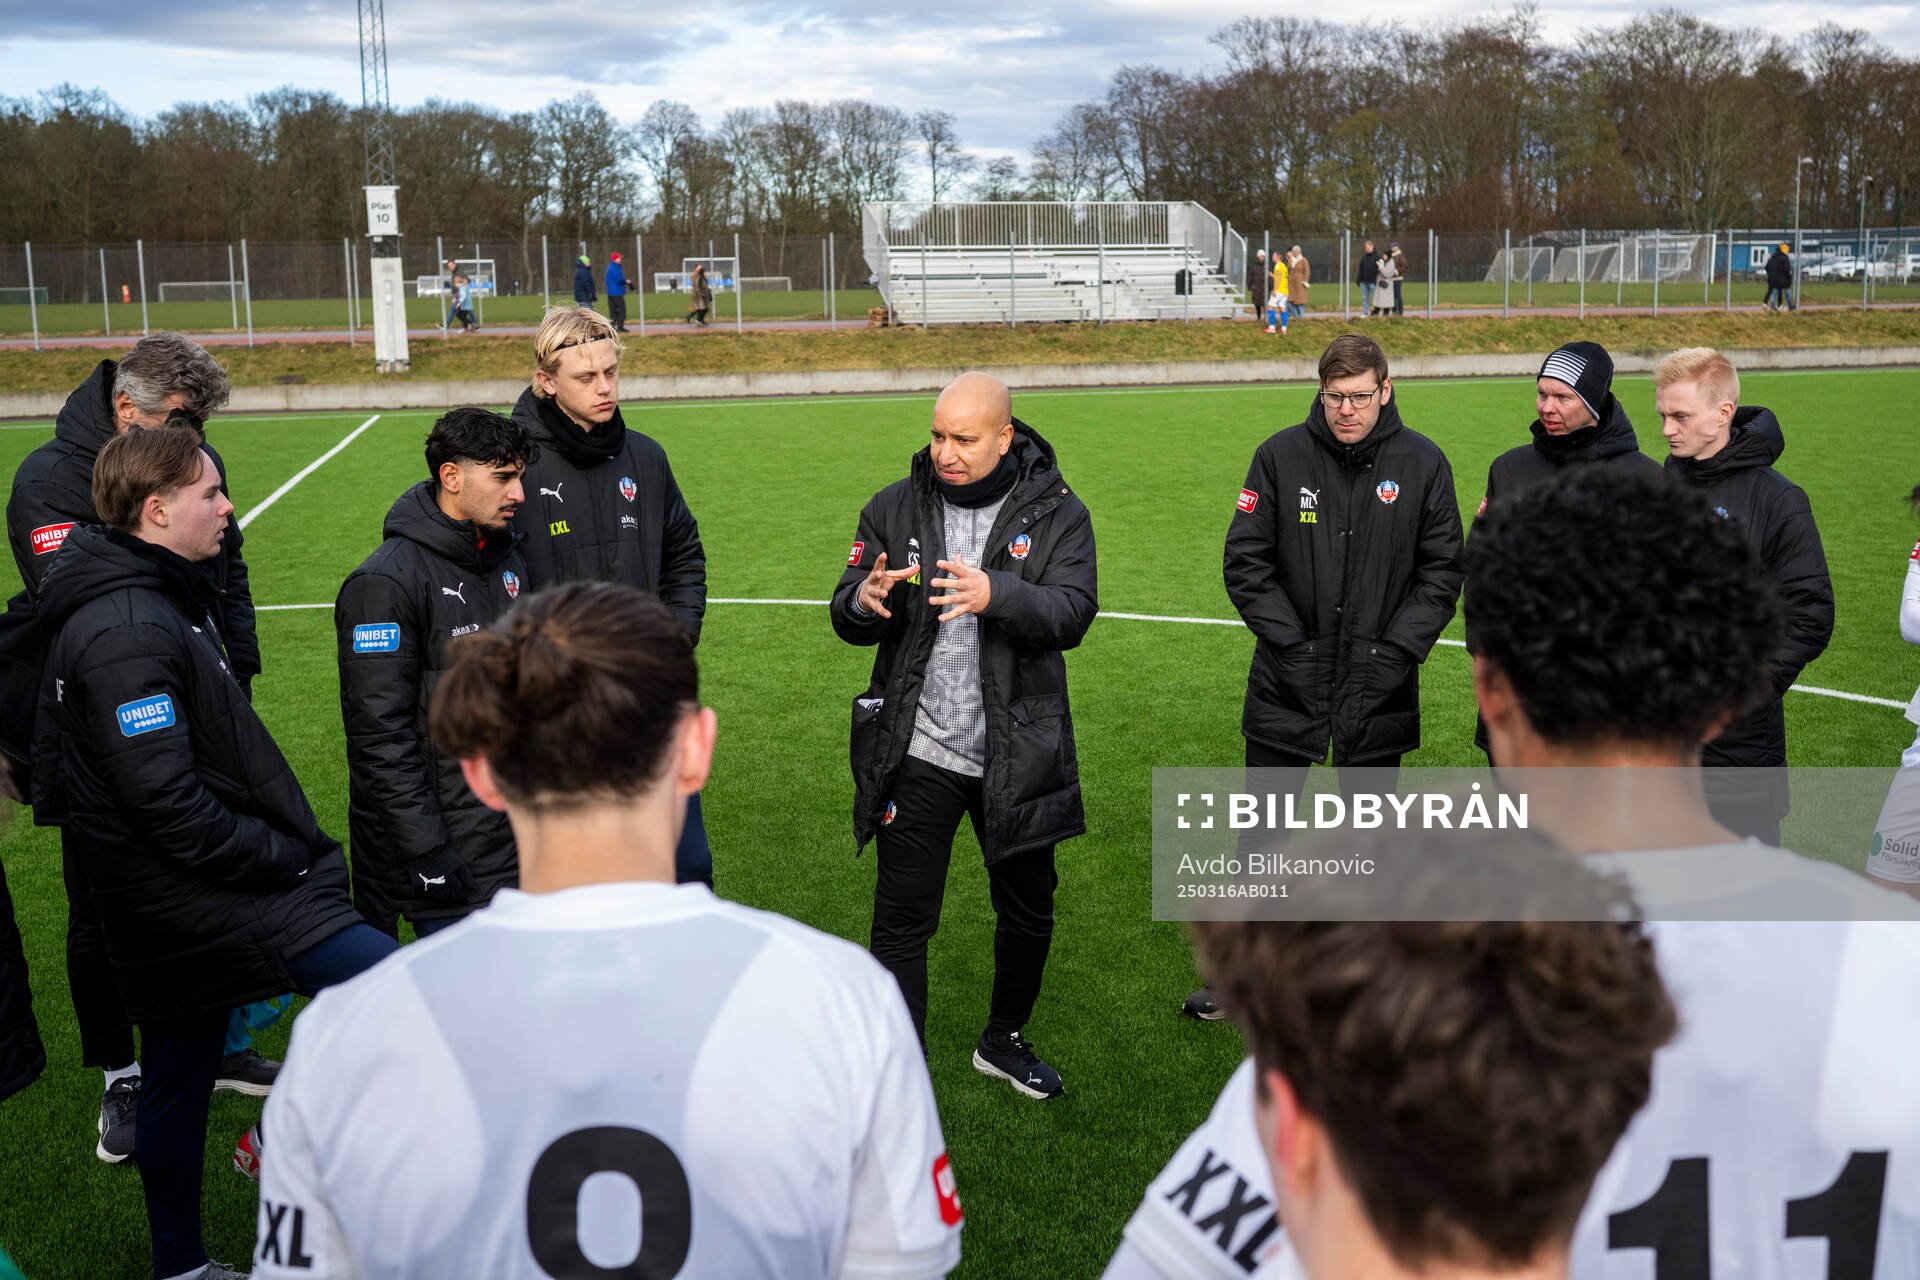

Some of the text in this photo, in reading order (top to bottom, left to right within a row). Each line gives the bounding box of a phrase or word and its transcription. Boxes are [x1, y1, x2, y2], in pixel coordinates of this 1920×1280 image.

[371, 202, 392, 210] Plan
[376, 213, 390, 223] 10
[1300, 497, 1314, 509] ML
[1299, 511, 1317, 524] XXL
[33, 528, 71, 544] UNIBE
[549, 520, 570, 536] XXL
[355, 629, 397, 642] UNIBET
[452, 624, 471, 637] akea
[121, 701, 170, 724] UNIBET
[1884, 838, 1920, 857] Solid
[1881, 851, 1920, 868] Försäkrin
[1165, 1149, 1281, 1274] XXL
[1608, 1150, 1888, 1280] 11
[261, 1200, 312, 1268] XL
